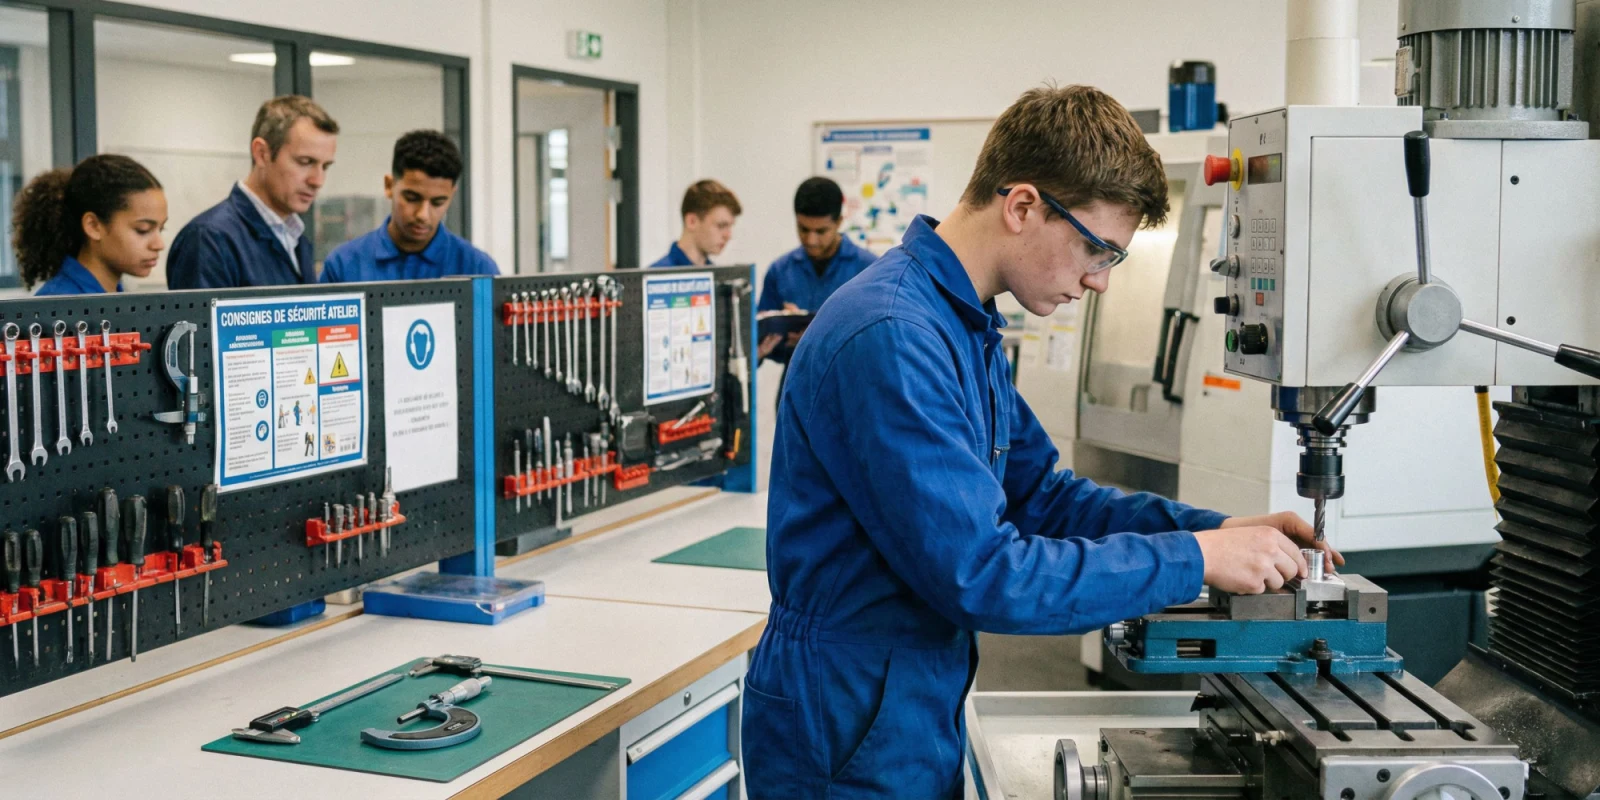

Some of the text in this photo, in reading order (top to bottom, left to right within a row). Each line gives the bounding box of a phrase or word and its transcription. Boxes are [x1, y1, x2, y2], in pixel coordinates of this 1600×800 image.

[221, 303, 358, 327] CONSIGNES DE SÉCURITÉ ATELIER
